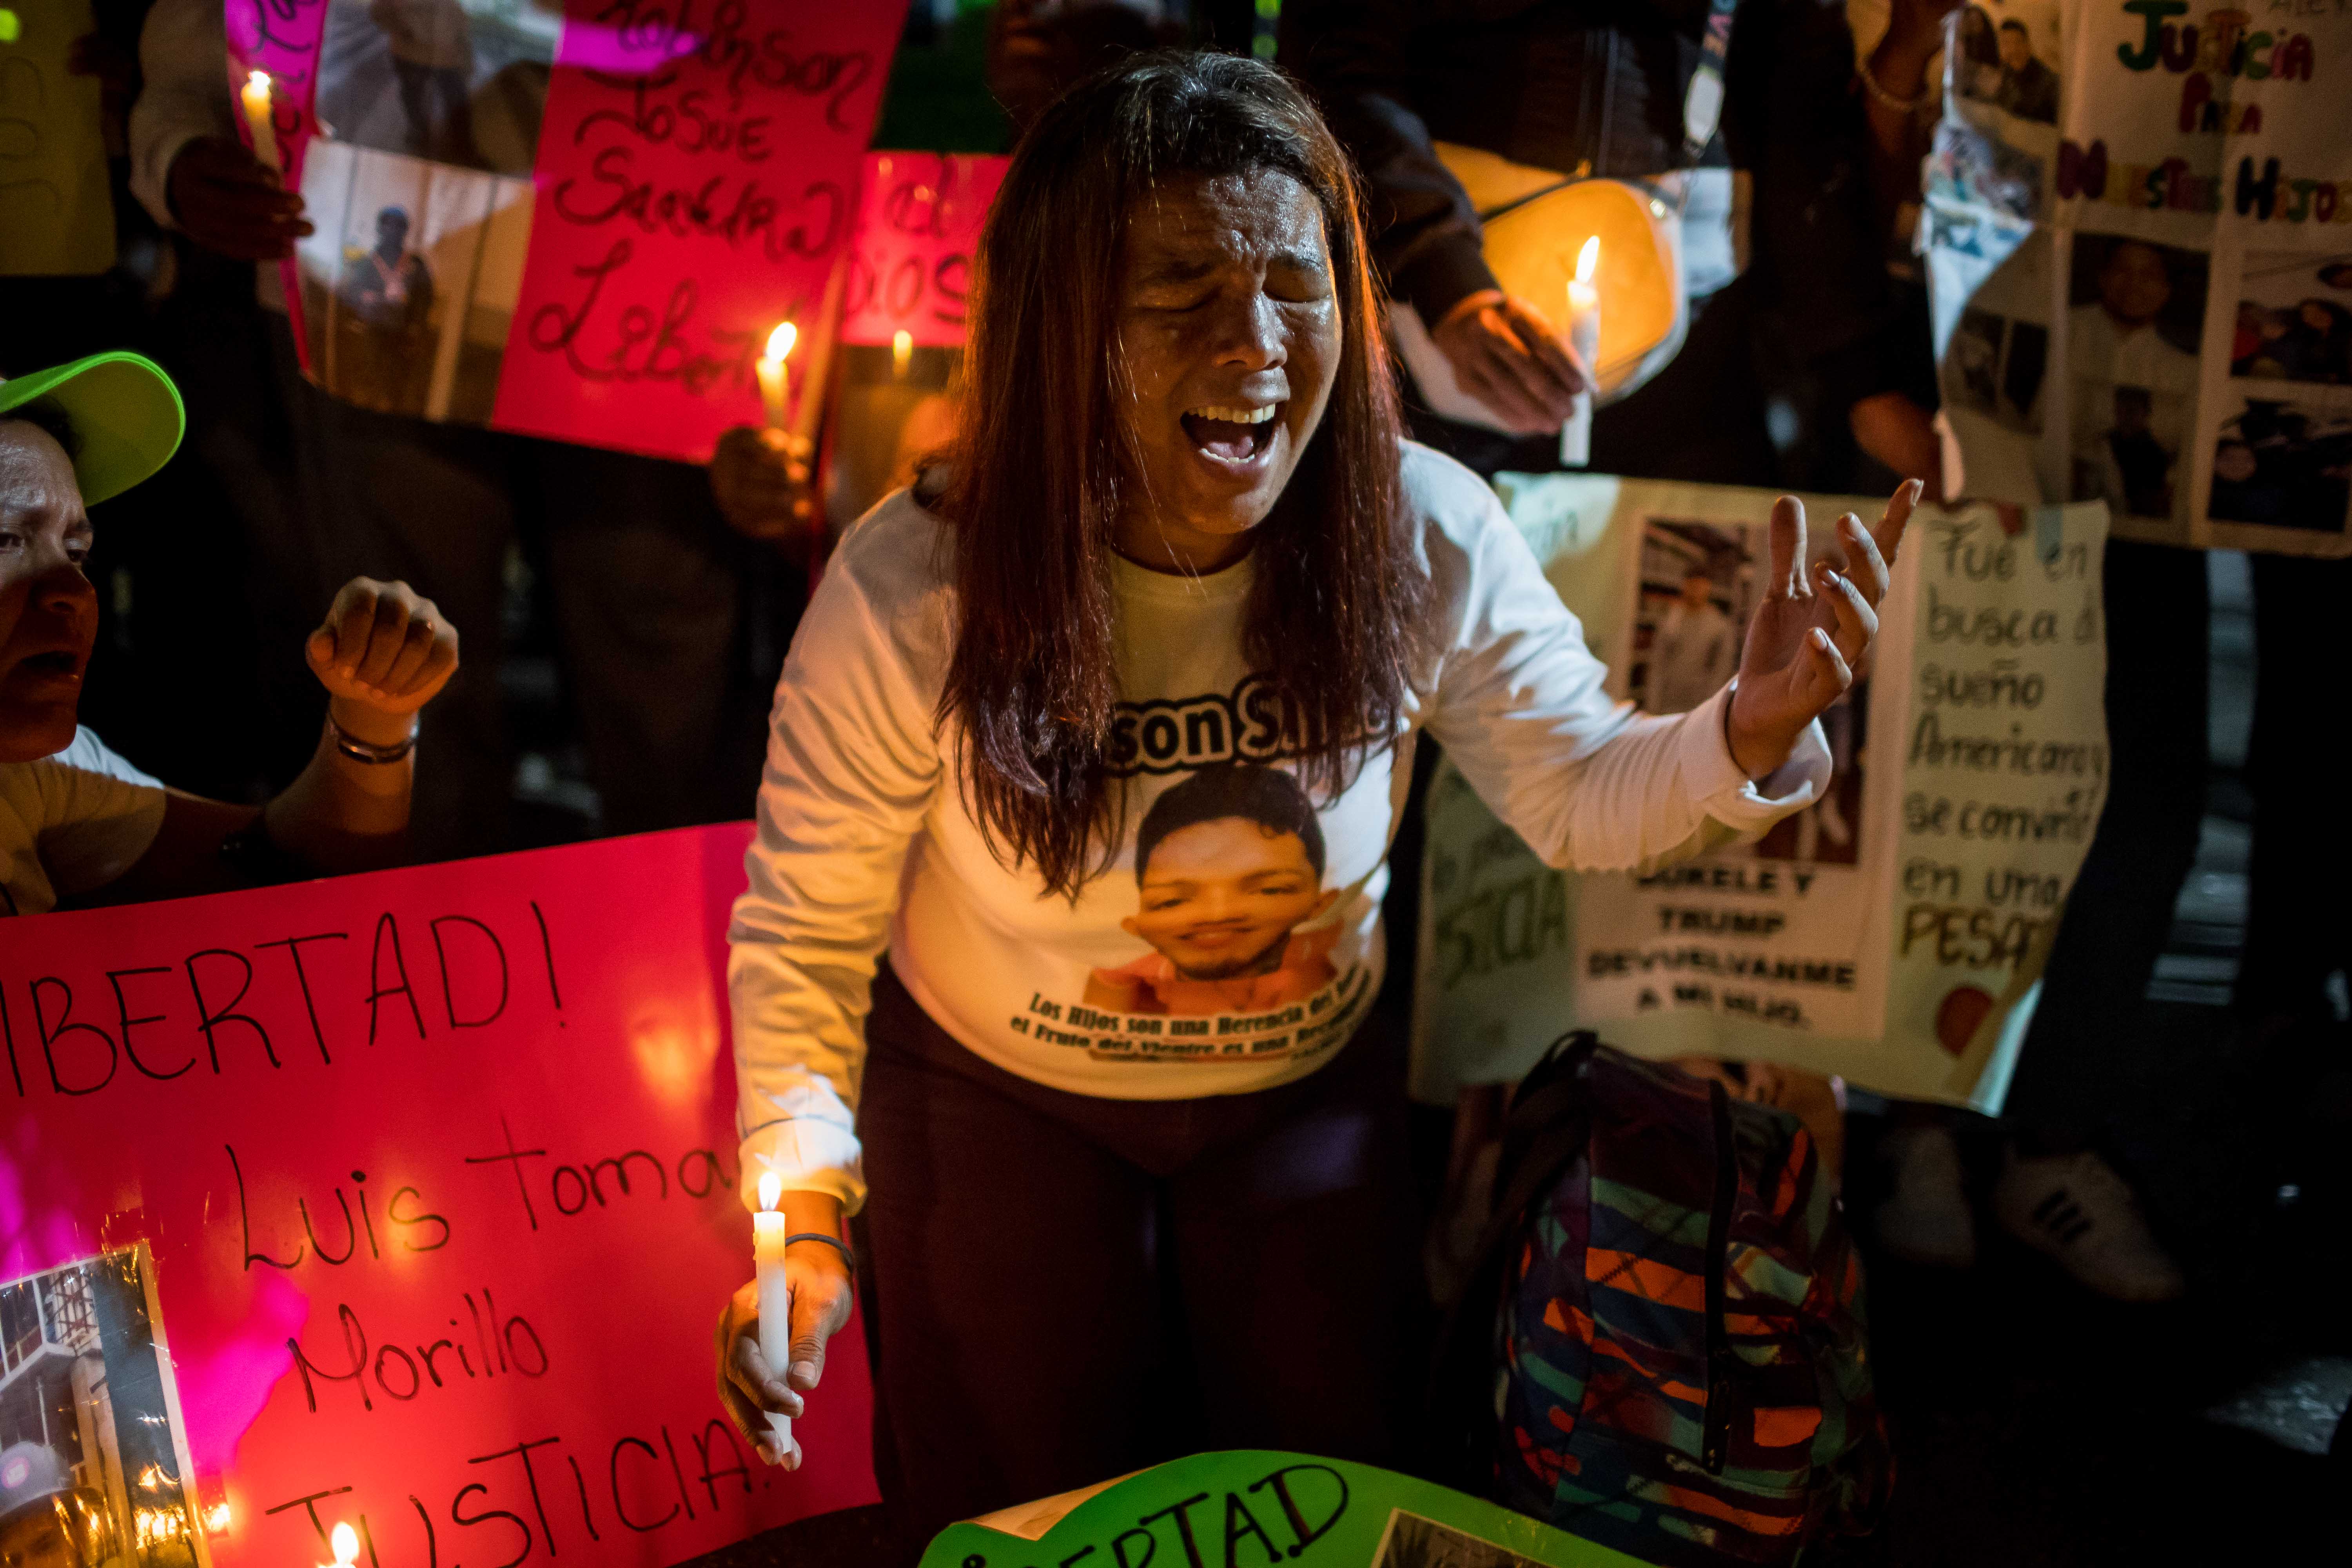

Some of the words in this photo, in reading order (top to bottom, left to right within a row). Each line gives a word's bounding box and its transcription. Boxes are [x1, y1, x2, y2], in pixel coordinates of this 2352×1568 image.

[1659, 906, 1786, 936] TRUMP
[0, 902, 566, 1098] IBERTAD!
[1029, 991, 1062, 1021] Los
[225, 1144, 450, 1271] Luis
[287, 1288, 549, 1414] Morillo
